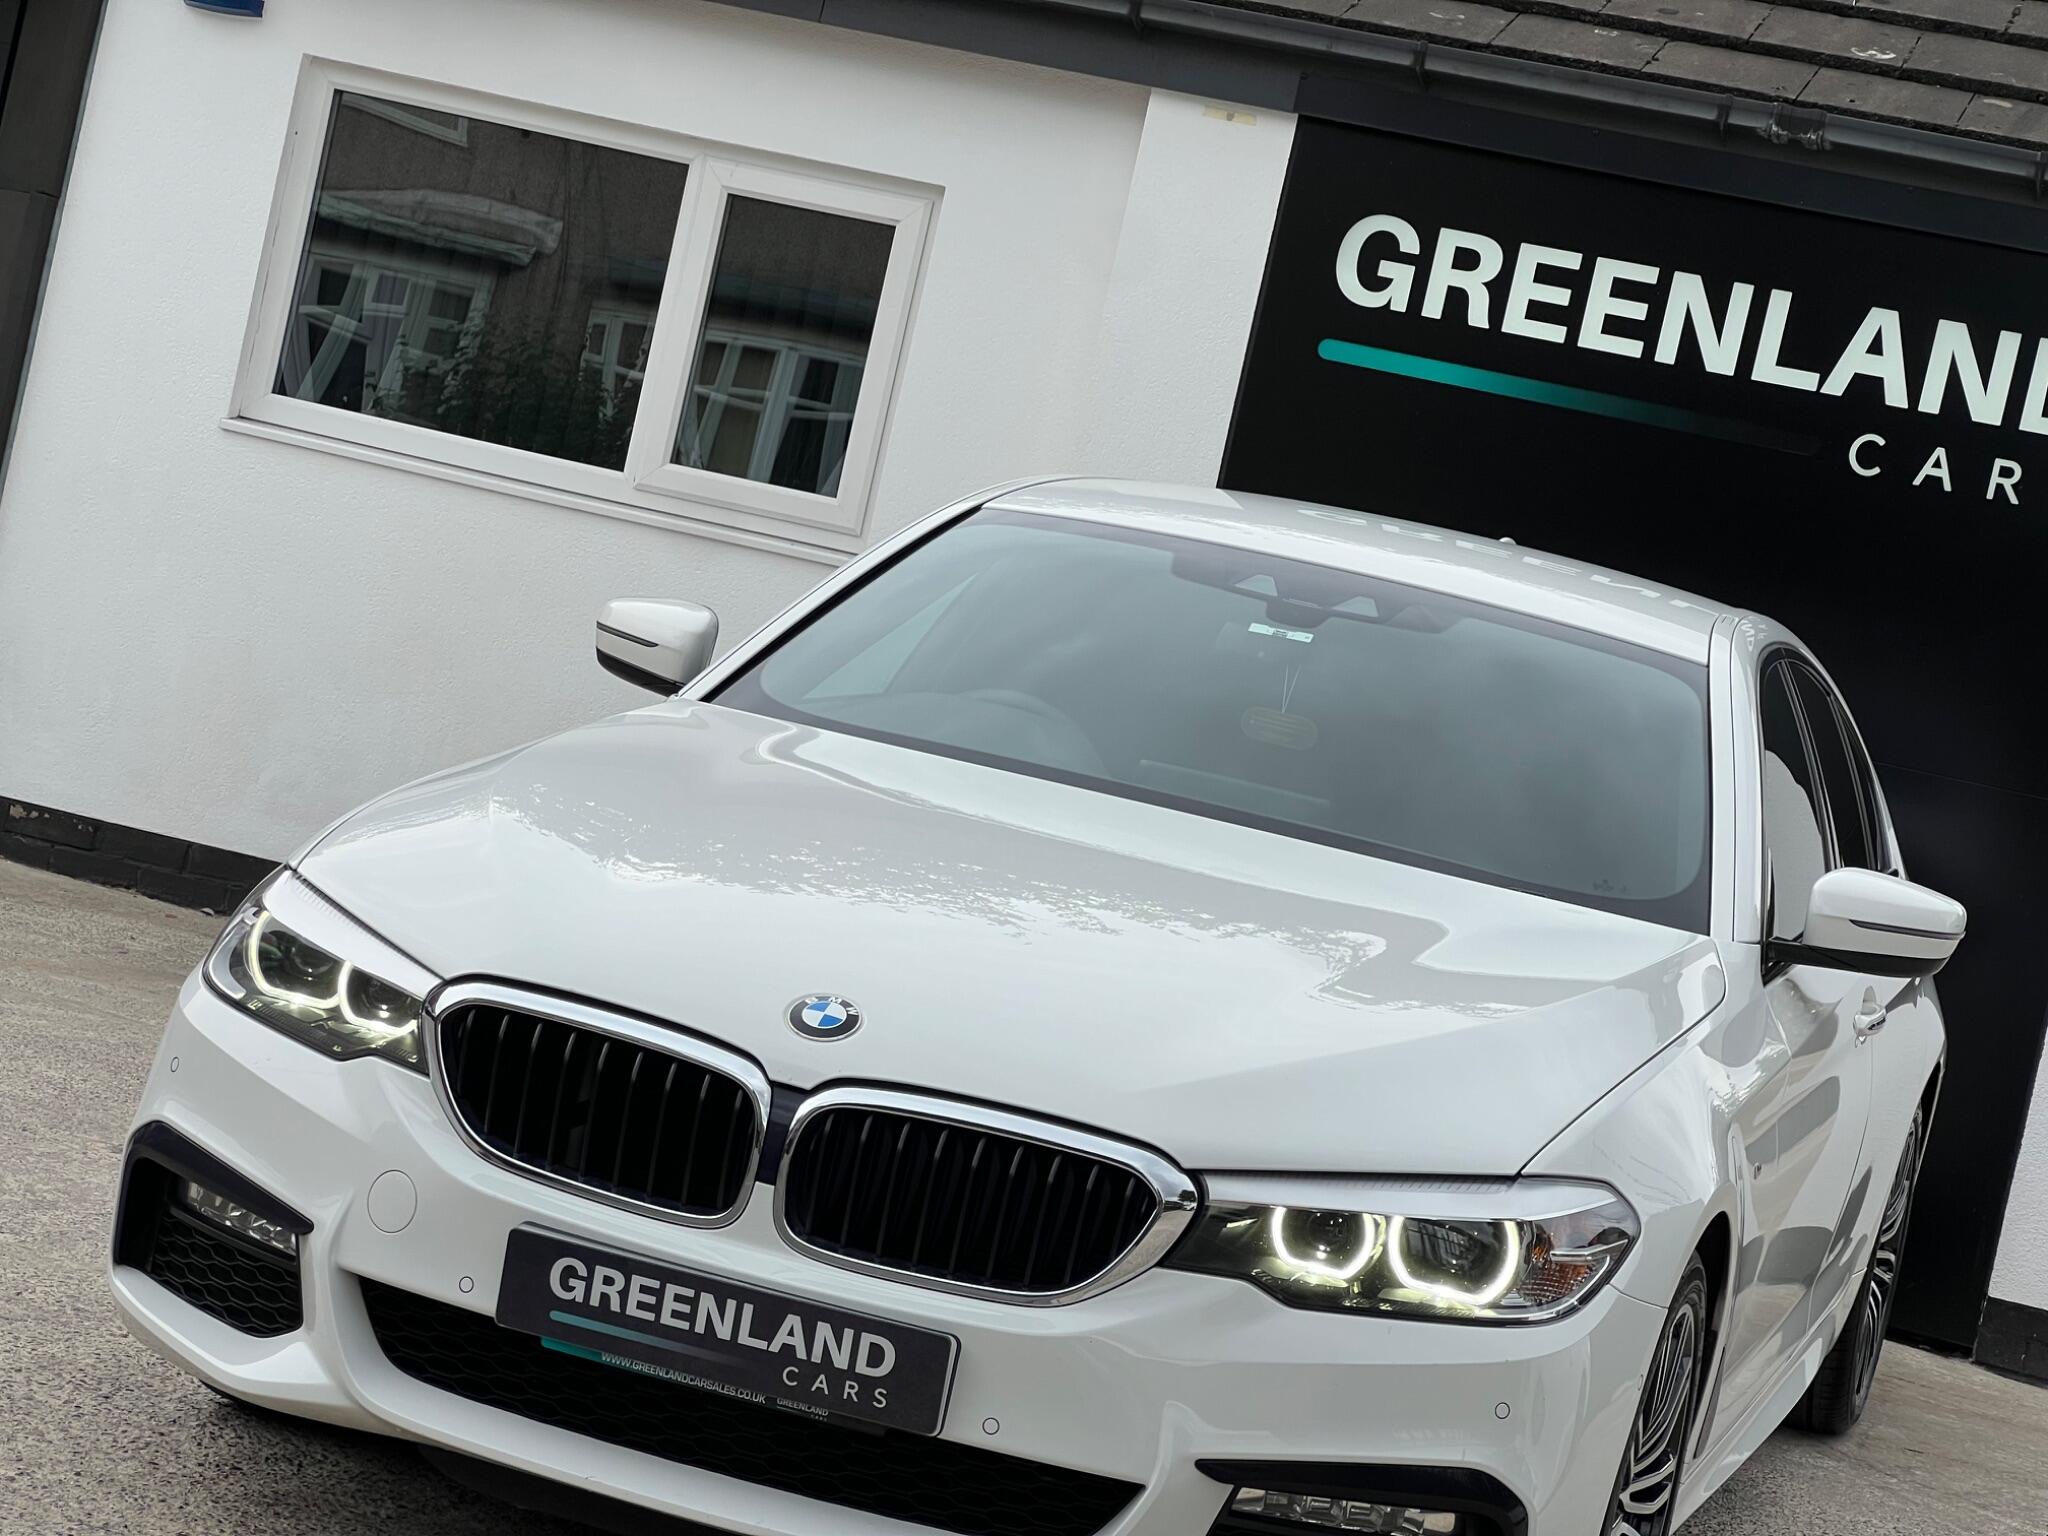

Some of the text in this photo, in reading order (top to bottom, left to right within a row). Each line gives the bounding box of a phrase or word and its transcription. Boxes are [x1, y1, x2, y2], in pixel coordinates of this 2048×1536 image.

[549, 1257, 896, 1378] GREENLAND
[601, 1351, 766, 1404] WWW.GREENLANDCARSALES.CO.UK
[782, 1366, 888, 1408] CARS
